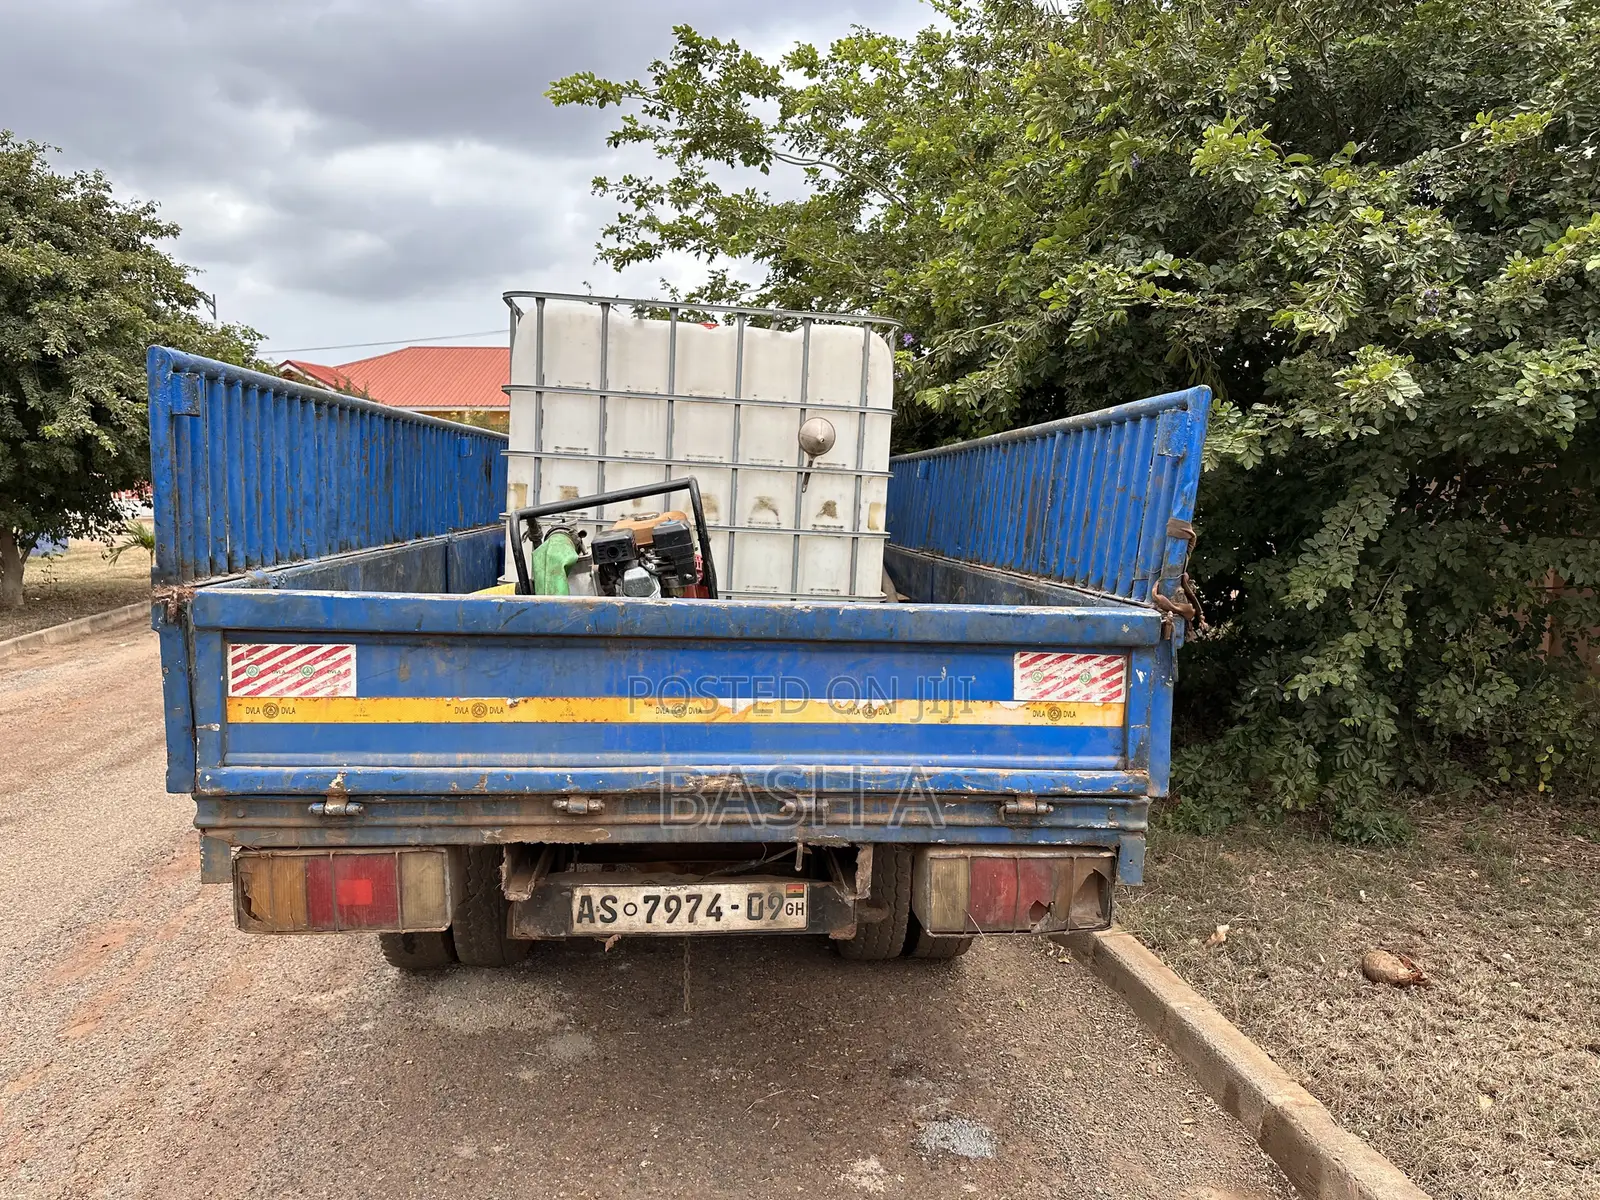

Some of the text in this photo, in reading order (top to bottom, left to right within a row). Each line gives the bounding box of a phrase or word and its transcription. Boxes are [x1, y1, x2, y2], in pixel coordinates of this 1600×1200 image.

[245, 706, 296, 715] DVLA DVLA
[454, 706, 504, 715] DVLA DVLA
[655, 706, 703, 715] DVLA DVLA
[1032, 710, 1077, 719] DVLA DVLA
[576, 894, 618, 924] AS
[785, 902, 804, 916] GH
